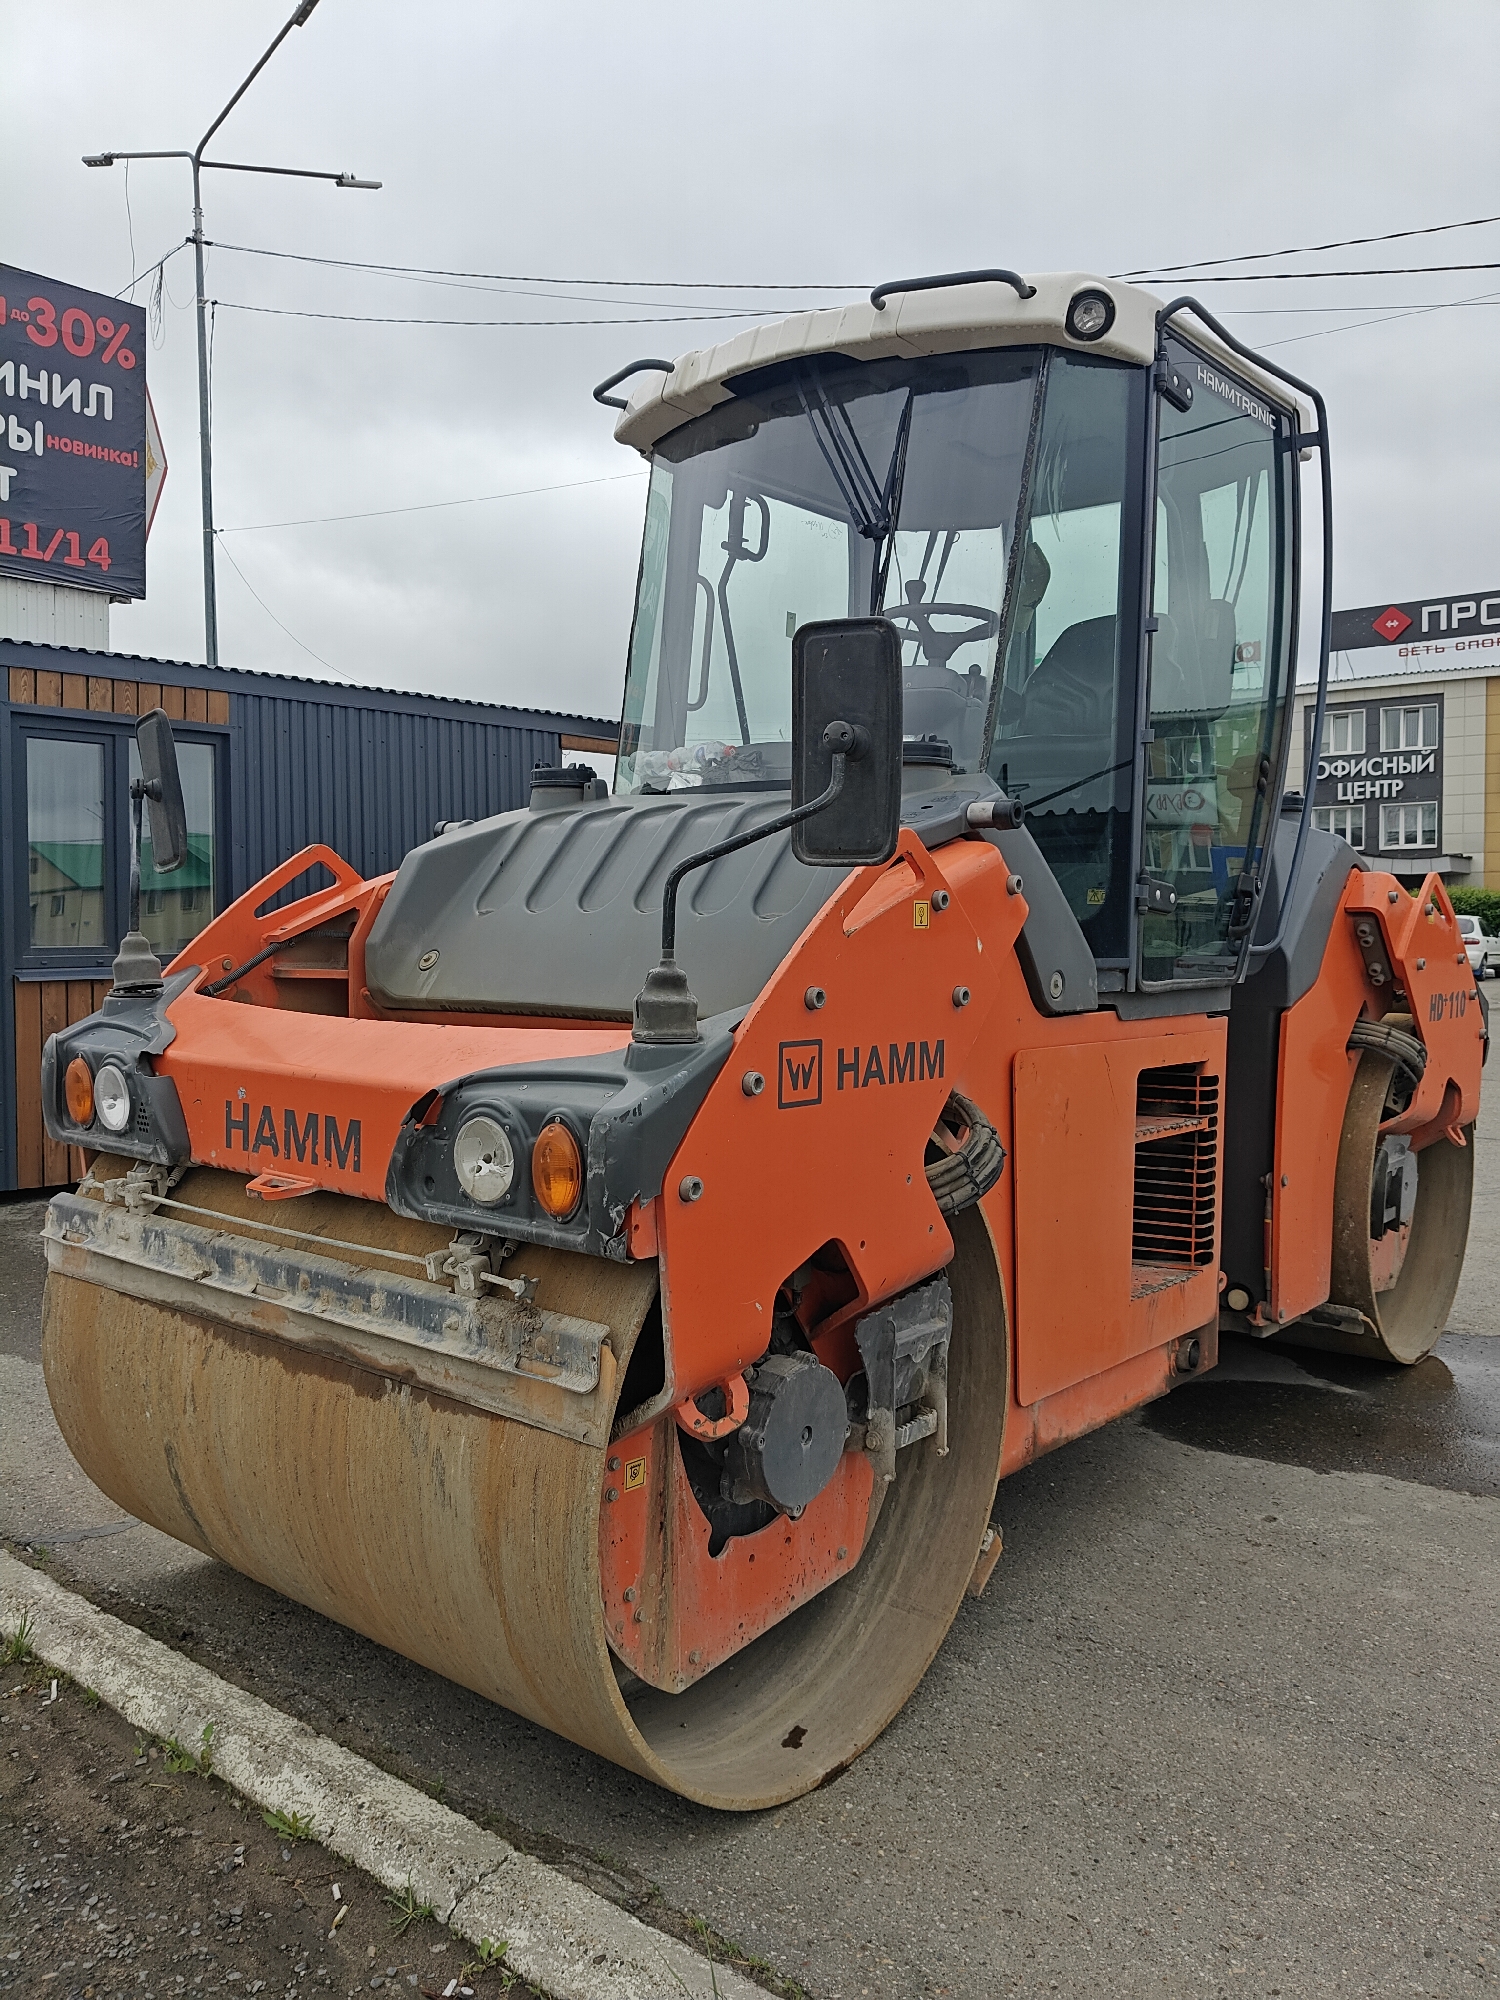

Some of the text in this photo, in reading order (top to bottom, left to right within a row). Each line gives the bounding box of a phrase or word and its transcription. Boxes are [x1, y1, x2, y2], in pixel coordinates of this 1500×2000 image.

[26, 296, 136, 370] 30%
[1197, 365, 1277, 430] HAMMTRONIC
[0, 518, 112, 571] 11/14
[1398, 644, 1446, 657] СЕТЬ
[1316, 750, 1435, 779] ОФИСНЫЙ
[1337, 779, 1405, 804] ЦЕНТР
[837, 1039, 945, 1091] HAMM
[225, 1099, 362, 1173] HAMM
